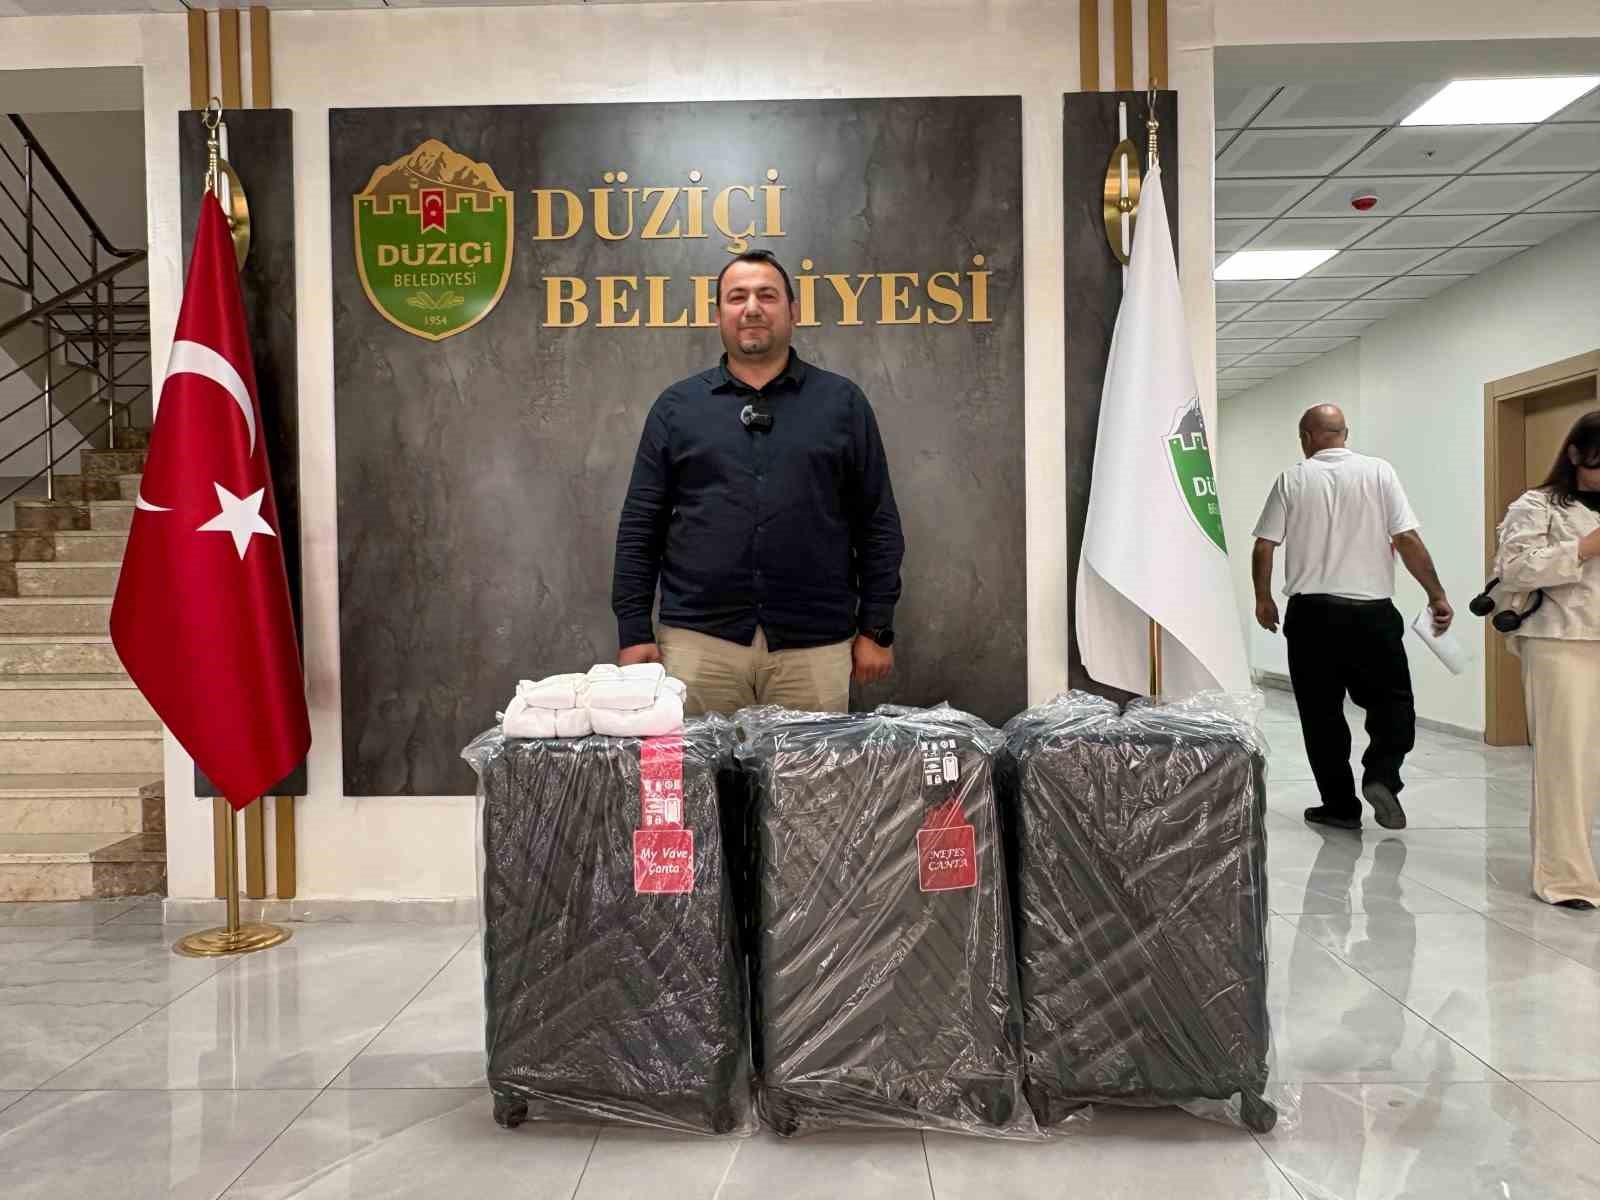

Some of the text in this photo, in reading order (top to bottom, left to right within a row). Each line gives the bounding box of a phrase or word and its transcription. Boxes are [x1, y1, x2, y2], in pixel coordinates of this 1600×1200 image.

[532, 168, 787, 255] DÜZİÇİ
[377, 241, 493, 268] DÜZİÇİ
[393, 271, 477, 288] BELEDİYESİ
[541, 254, 994, 329] BELEİYESİ
[424, 315, 448, 326] 1954
[640, 848, 658, 864] My
